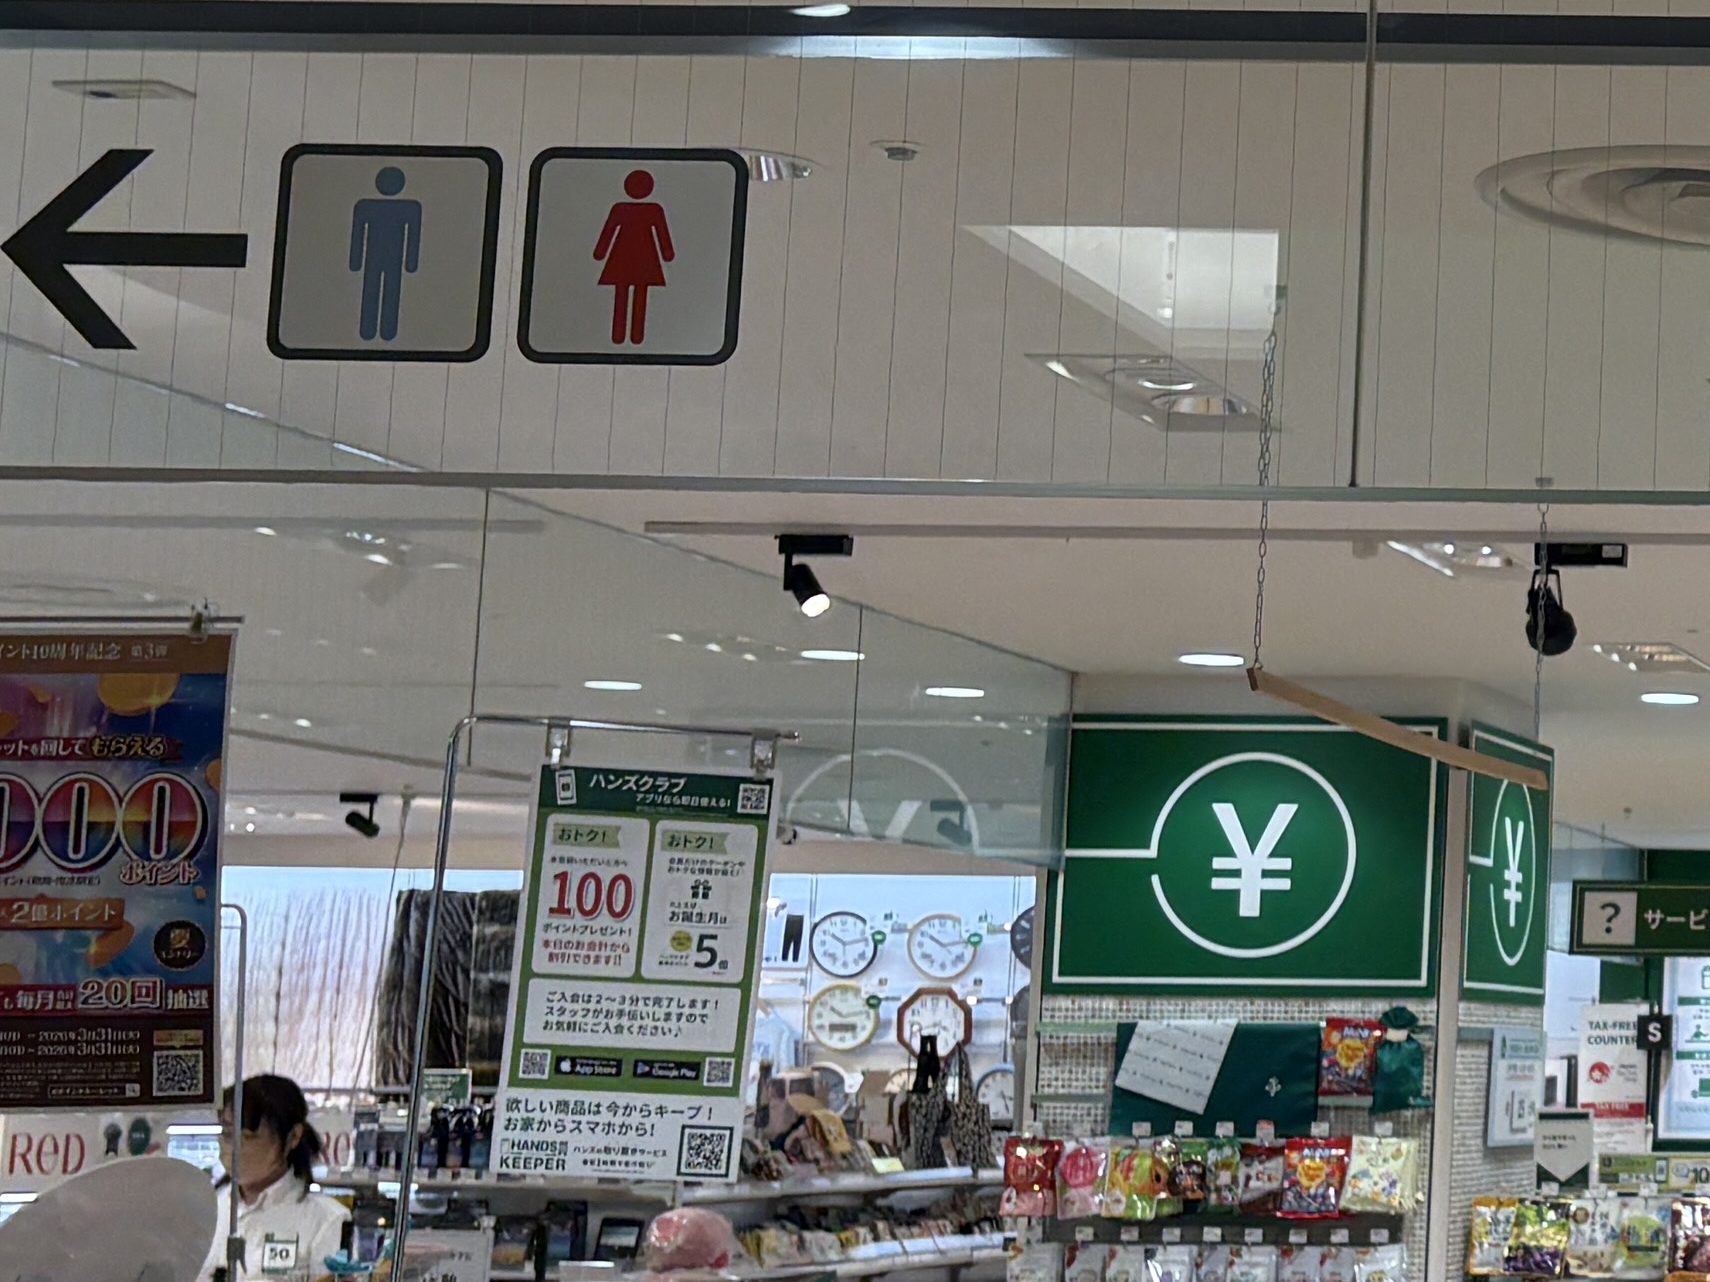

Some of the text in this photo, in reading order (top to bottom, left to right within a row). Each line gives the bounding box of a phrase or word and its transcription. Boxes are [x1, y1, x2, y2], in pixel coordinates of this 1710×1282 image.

[589, 773, 687, 794] ハンズクラブ
[548, 870, 635, 922] 100
[1647, 1022, 1662, 1042] S
[499, 1155, 567, 1172] KEEPER
